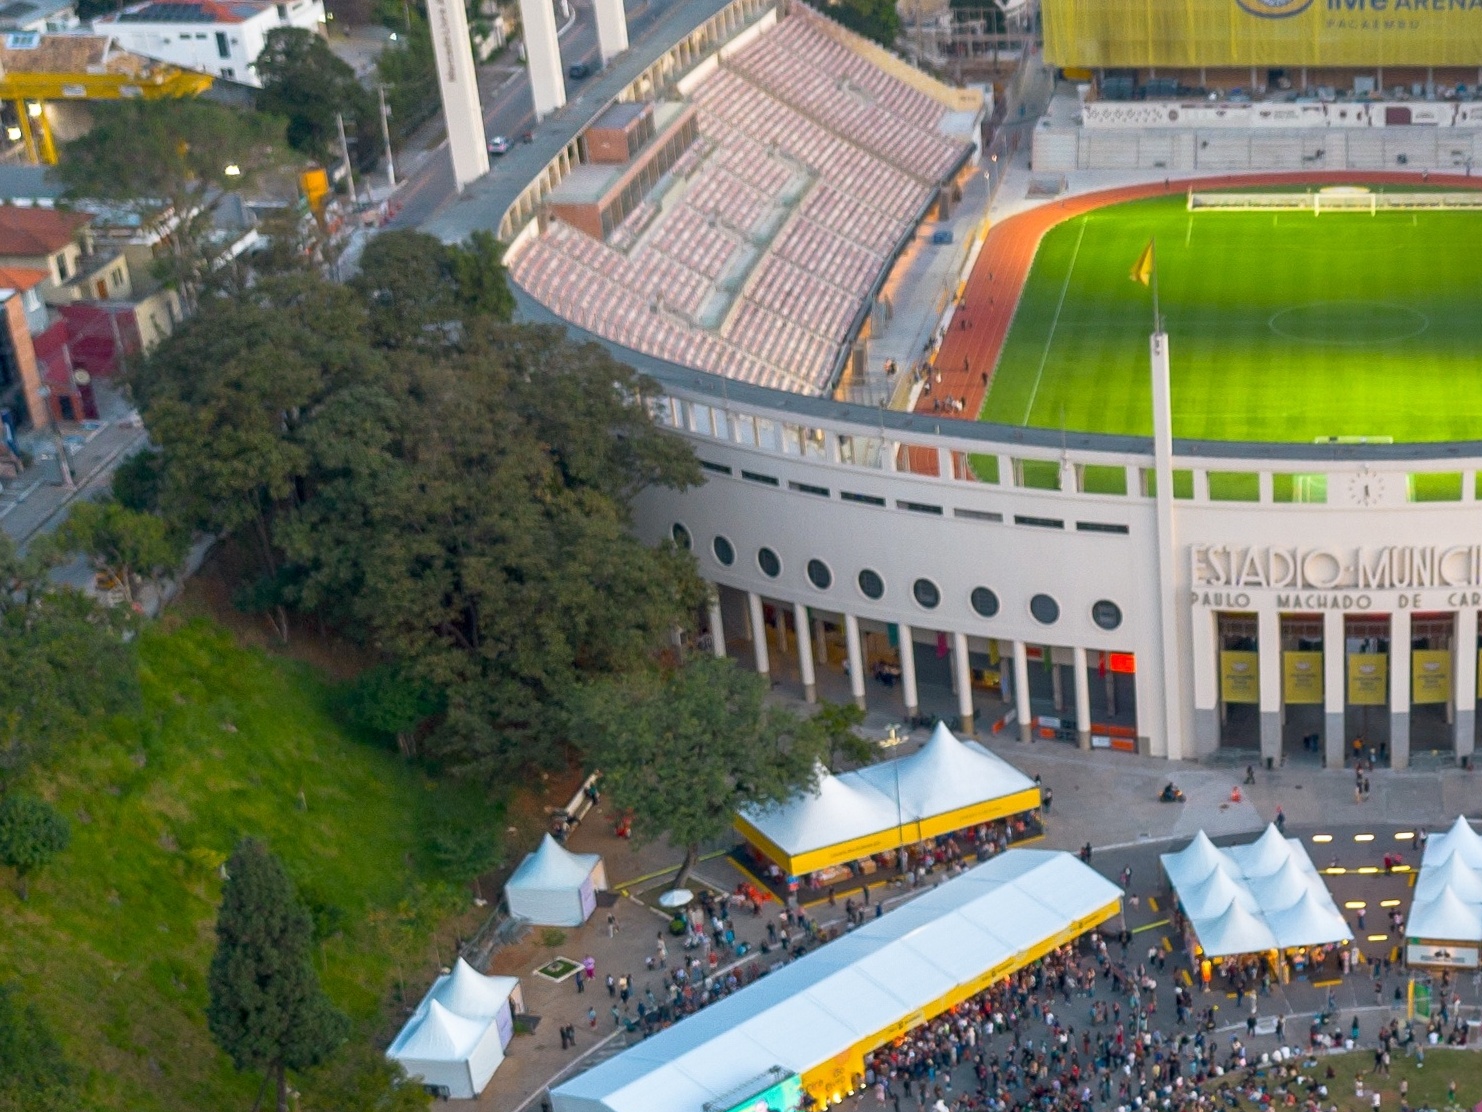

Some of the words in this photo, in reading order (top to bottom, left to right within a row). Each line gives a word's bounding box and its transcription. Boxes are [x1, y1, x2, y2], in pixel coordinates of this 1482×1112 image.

[1190, 591, 1251, 608] PAULO
[1276, 593, 1372, 610] MACHADO
[1399, 593, 1422, 609] DE
